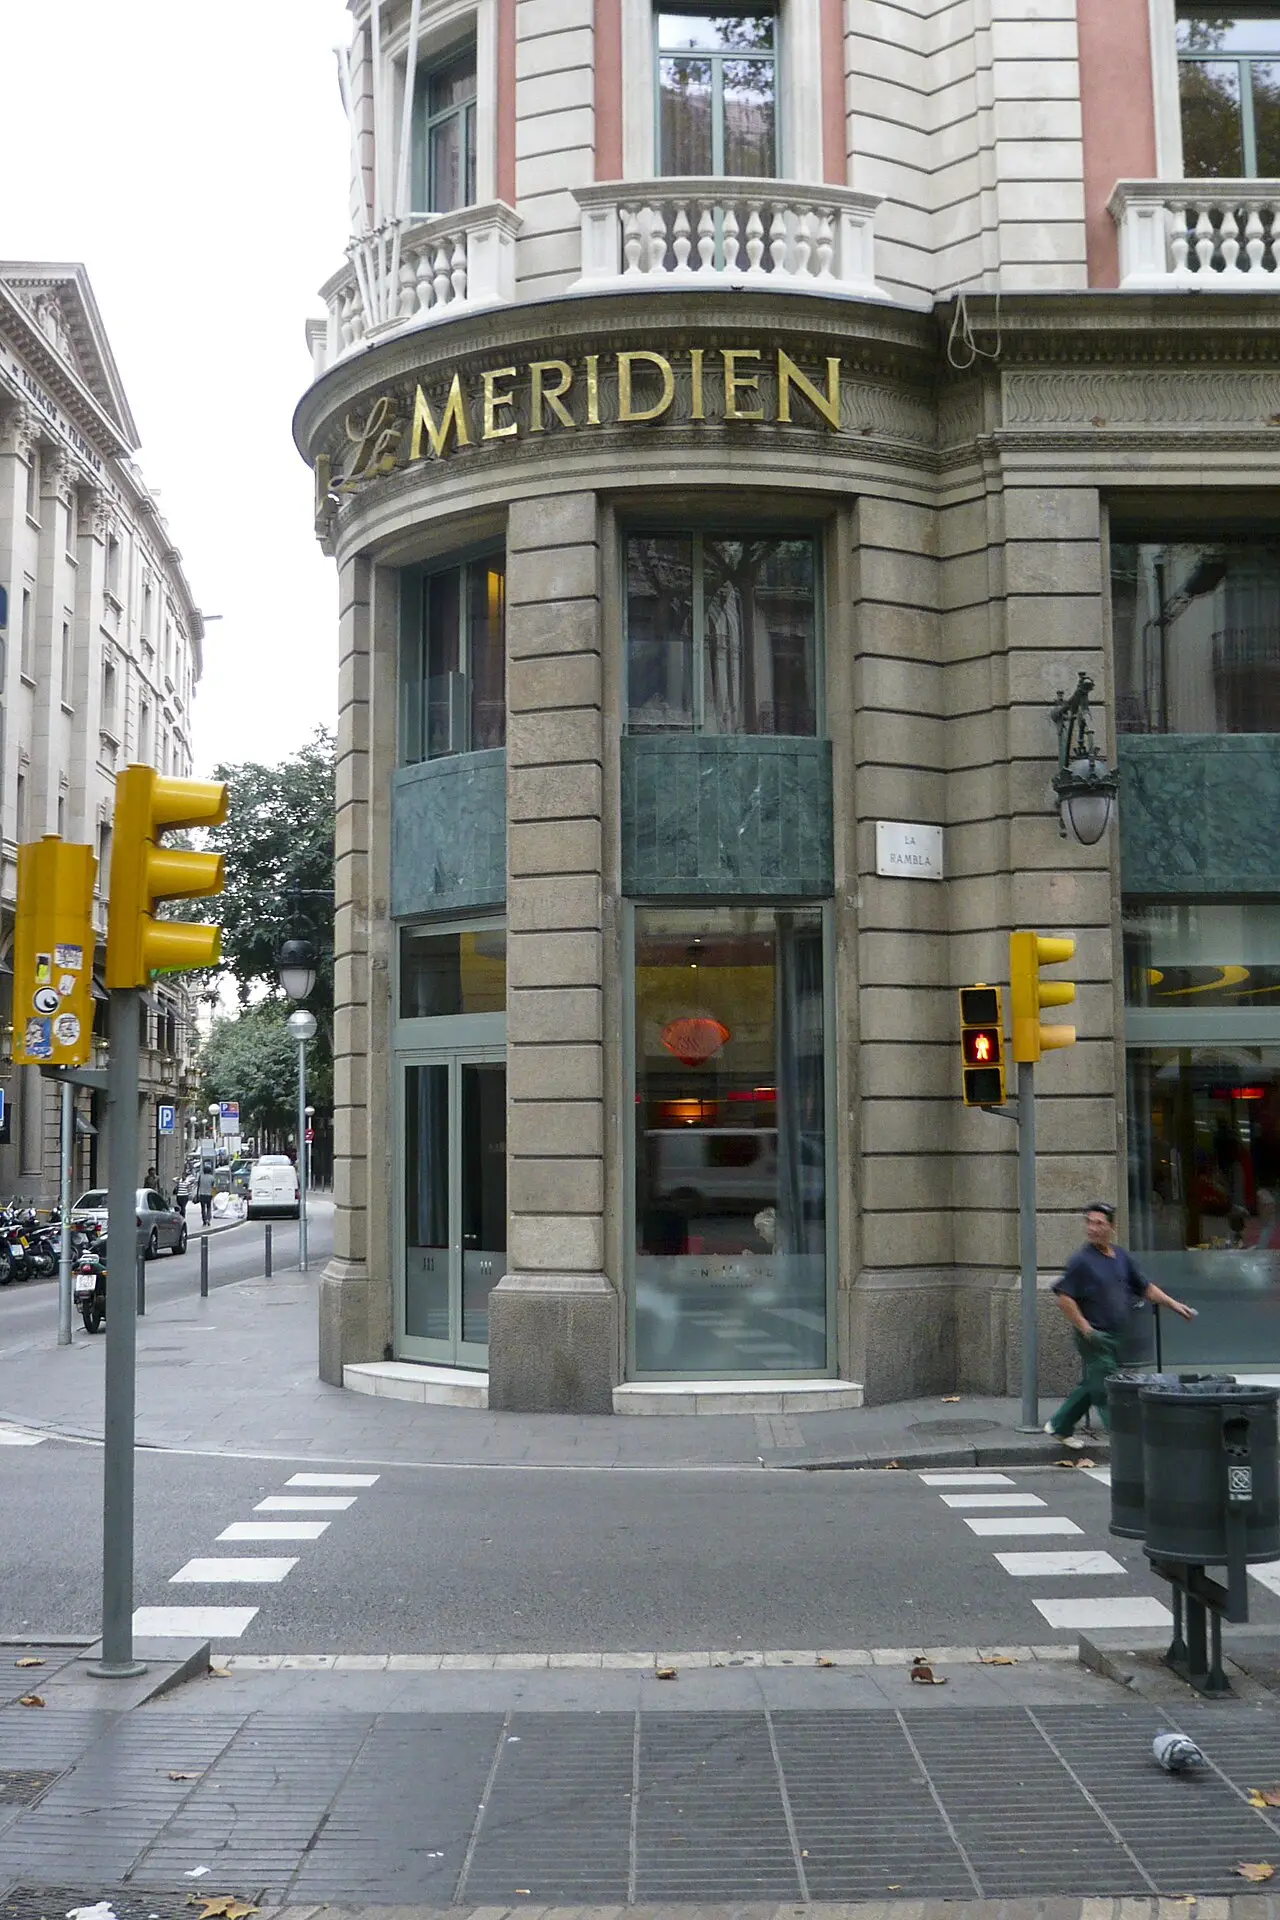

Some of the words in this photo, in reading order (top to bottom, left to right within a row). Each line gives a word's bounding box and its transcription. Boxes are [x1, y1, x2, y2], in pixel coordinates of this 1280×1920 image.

[409, 348, 841, 461] MERIDIEN
[904, 835, 916, 845] LA
[889, 852, 932, 866] RAMBLA
[163, 1109, 171, 1127] P
